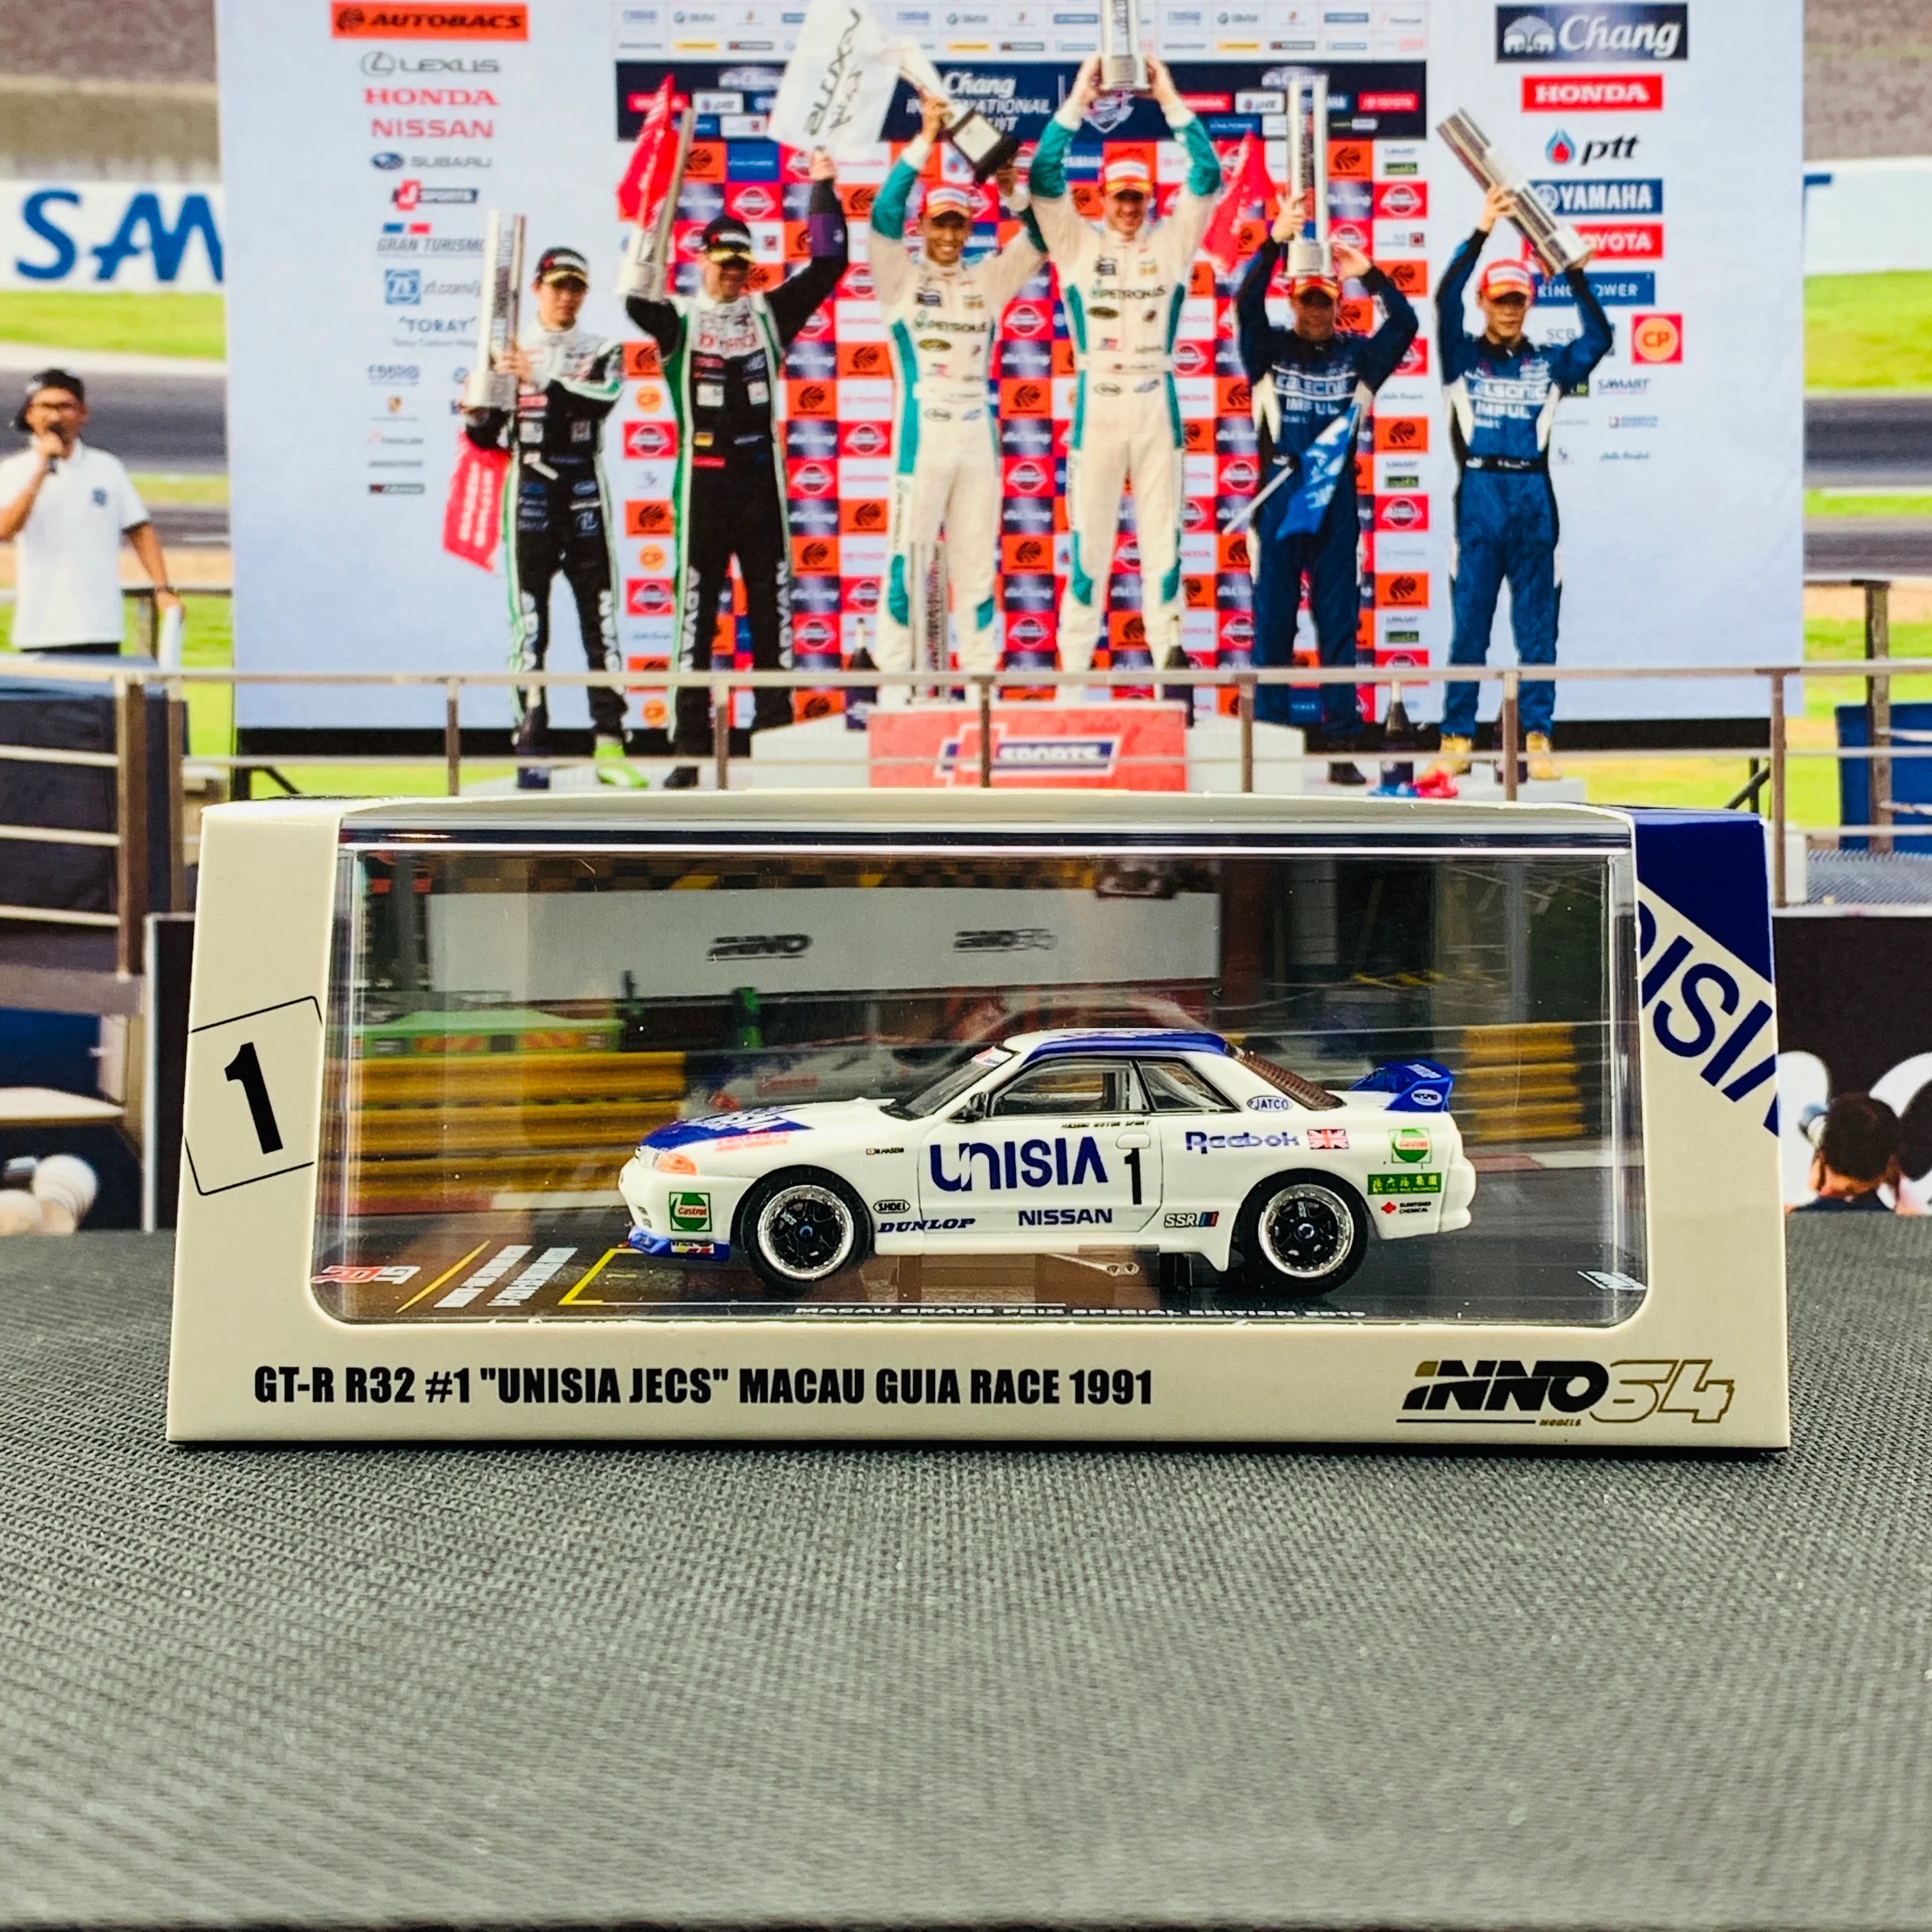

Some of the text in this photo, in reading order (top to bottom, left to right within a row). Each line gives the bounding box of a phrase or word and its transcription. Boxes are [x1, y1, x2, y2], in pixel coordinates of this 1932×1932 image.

[369, 13, 521, 29] AUTOBACS
[1559, 14, 1682, 57] Chang
[399, 58, 501, 73] LEXUS
[942, 70, 1016, 99] Chang
[1535, 83, 1650, 103] HONDA
[363, 88, 500, 106] HONDA
[371, 119, 494, 138] NISSAN
[1581, 134, 1641, 166] ptt
[410, 157, 493, 167] SUBARU
[1559, 185, 1653, 210] YAMAHA
[424, 238, 486, 252] TURISM
[1583, 233, 1652, 252] OYOTA
[1595, 282, 1638, 297] OWER
[1641, 330, 1671, 348] CP
[224, 1041, 284, 1155] 1
[1253, 1097, 1289, 1111] JATCO
[1184, 1130, 1300, 1154] Reebok
[930, 1136, 1109, 1192] UNISIA
[1124, 1147, 1142, 1206] 1
[878, 1202, 905, 1212] SHOEI
[877, 1217, 976, 1234] DUNLOP
[1018, 1208, 1113, 1227] NISSAN
[1163, 1213, 1198, 1229] SSR
[254, 1366, 1153, 1405] GT-R R32 #1 "UNISIA JECS" MACAU GUIA RACE 1991
[1538, 1418, 1581, 1427] MODELS
